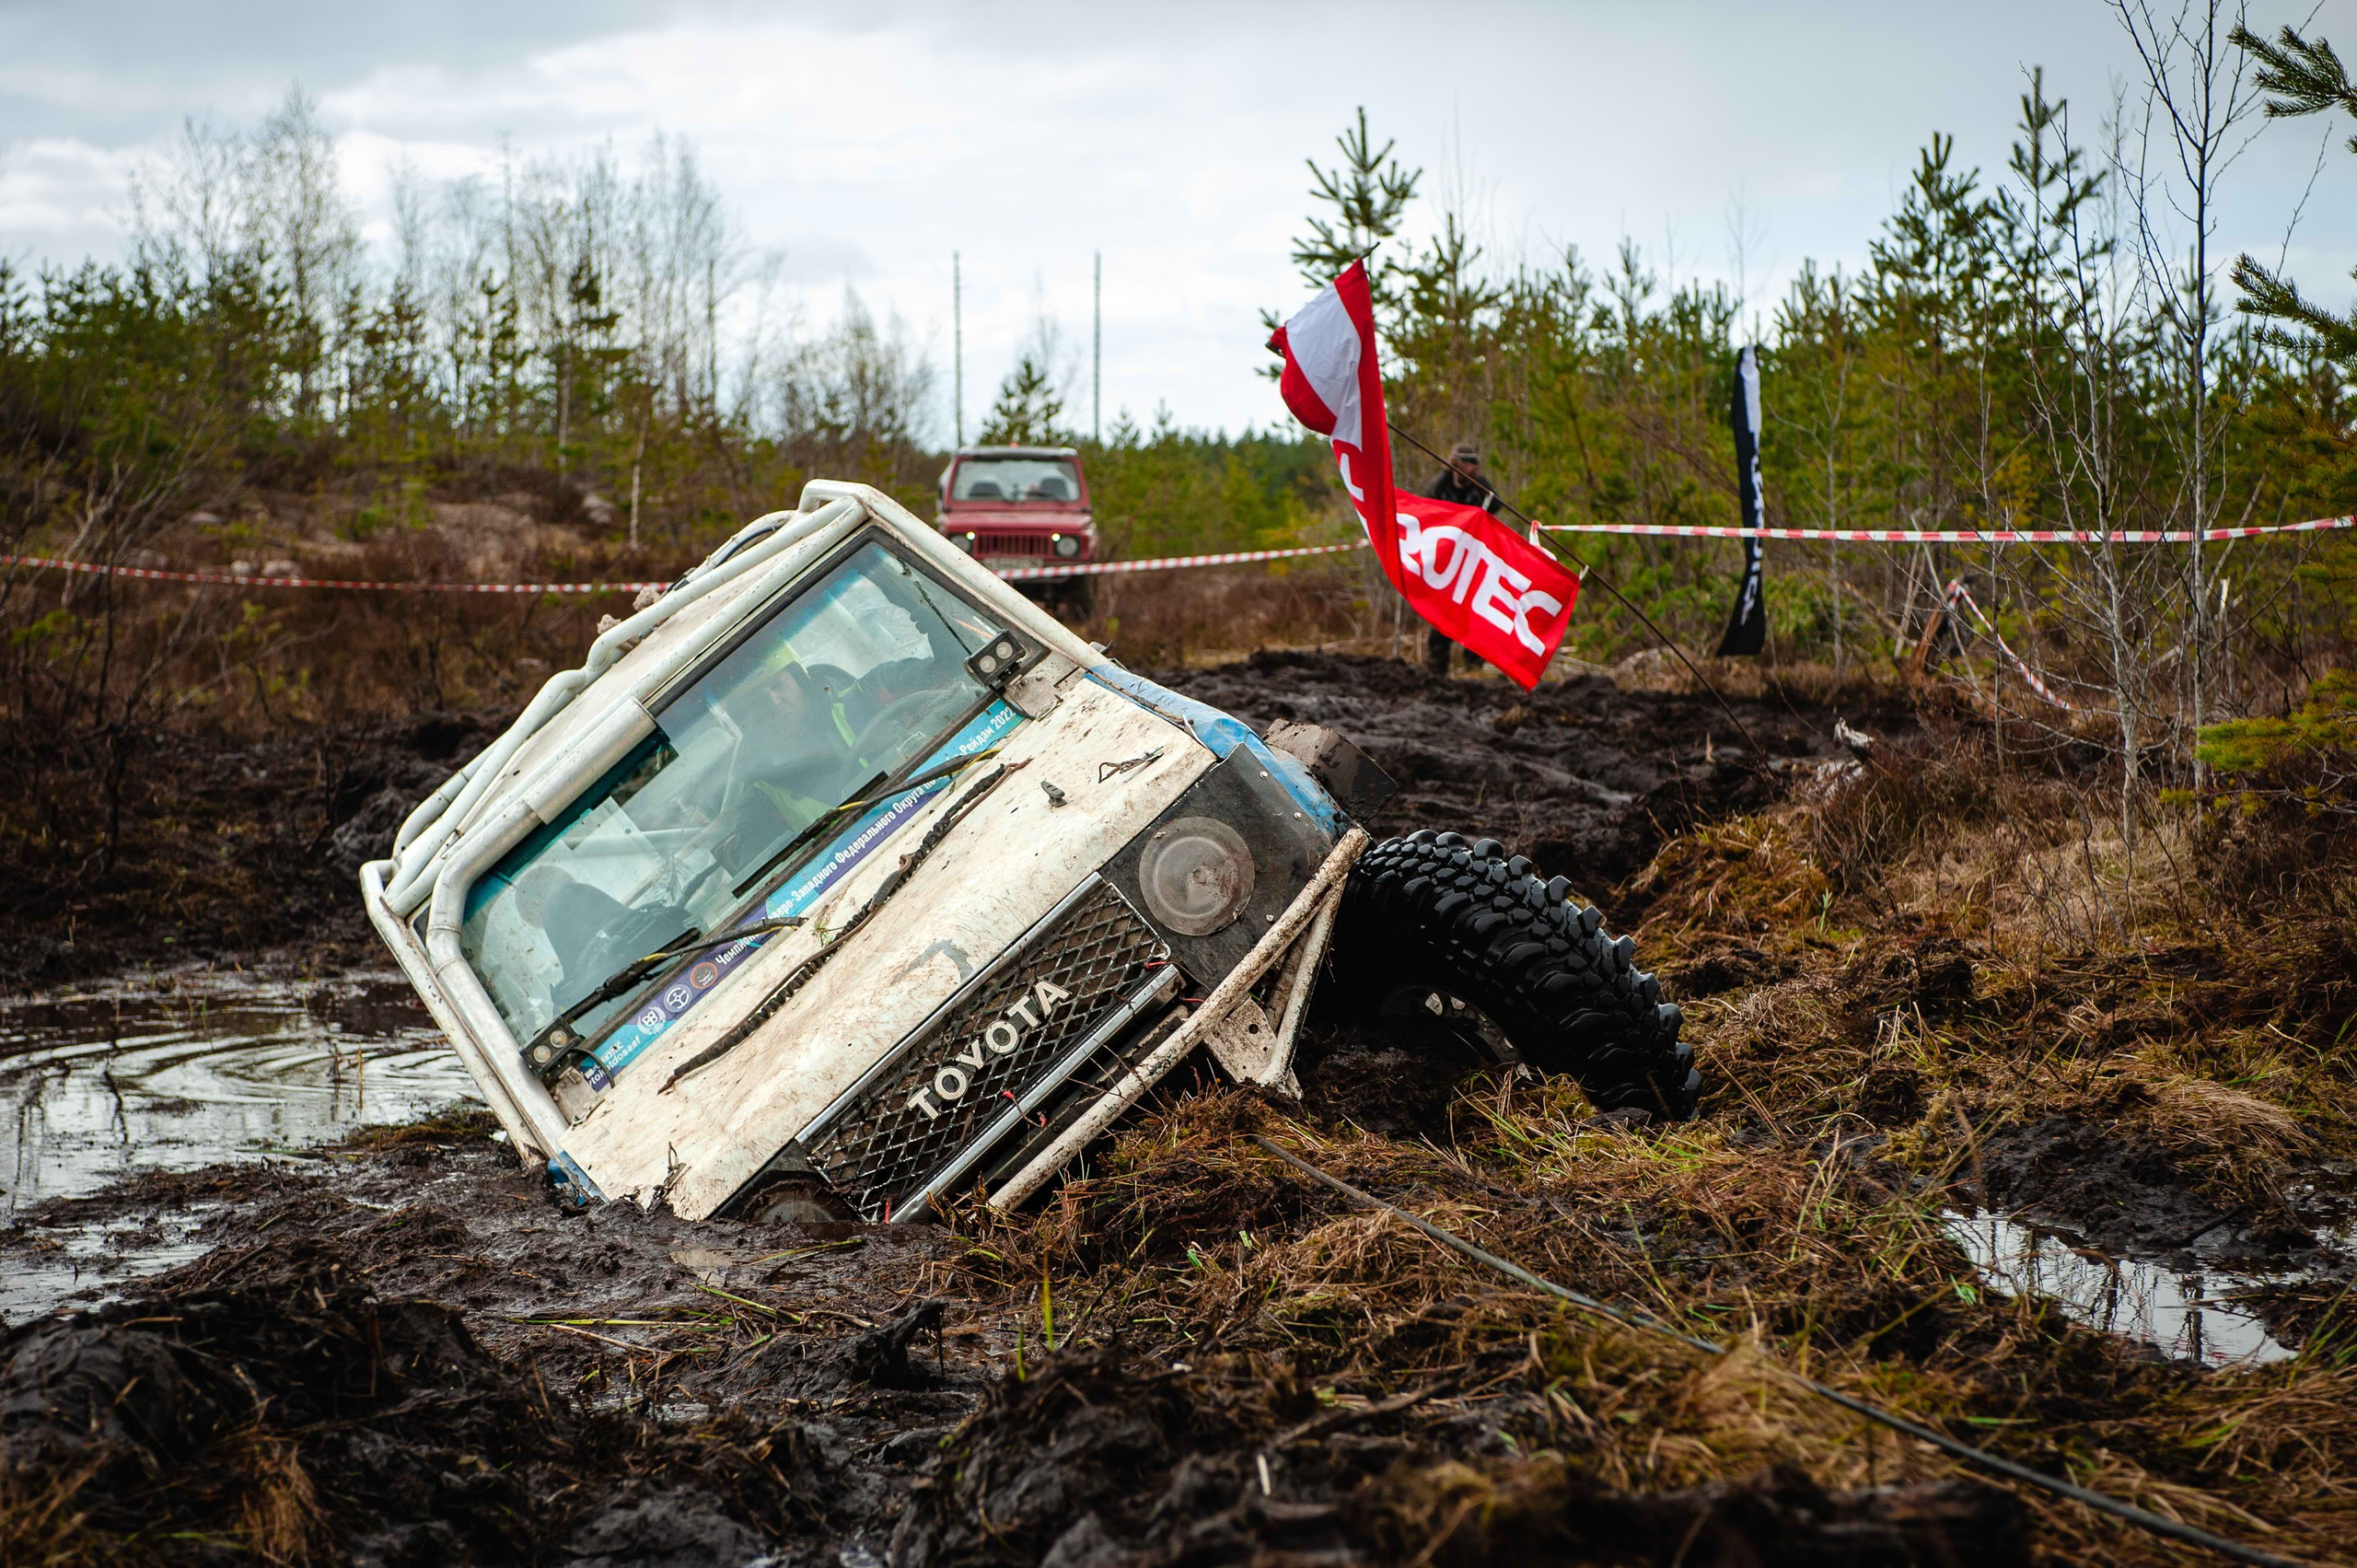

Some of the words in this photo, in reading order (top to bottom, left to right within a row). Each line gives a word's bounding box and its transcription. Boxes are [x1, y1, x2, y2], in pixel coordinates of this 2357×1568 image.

[1355, 507, 1562, 657] ROTEC
[714, 934, 761, 966] Чемпион
[834, 810, 897, 865] Федерального
[892, 785, 925, 815] Округа
[990, 706, 1016, 730] 2022
[906, 981, 1072, 1121] TOYOTA
